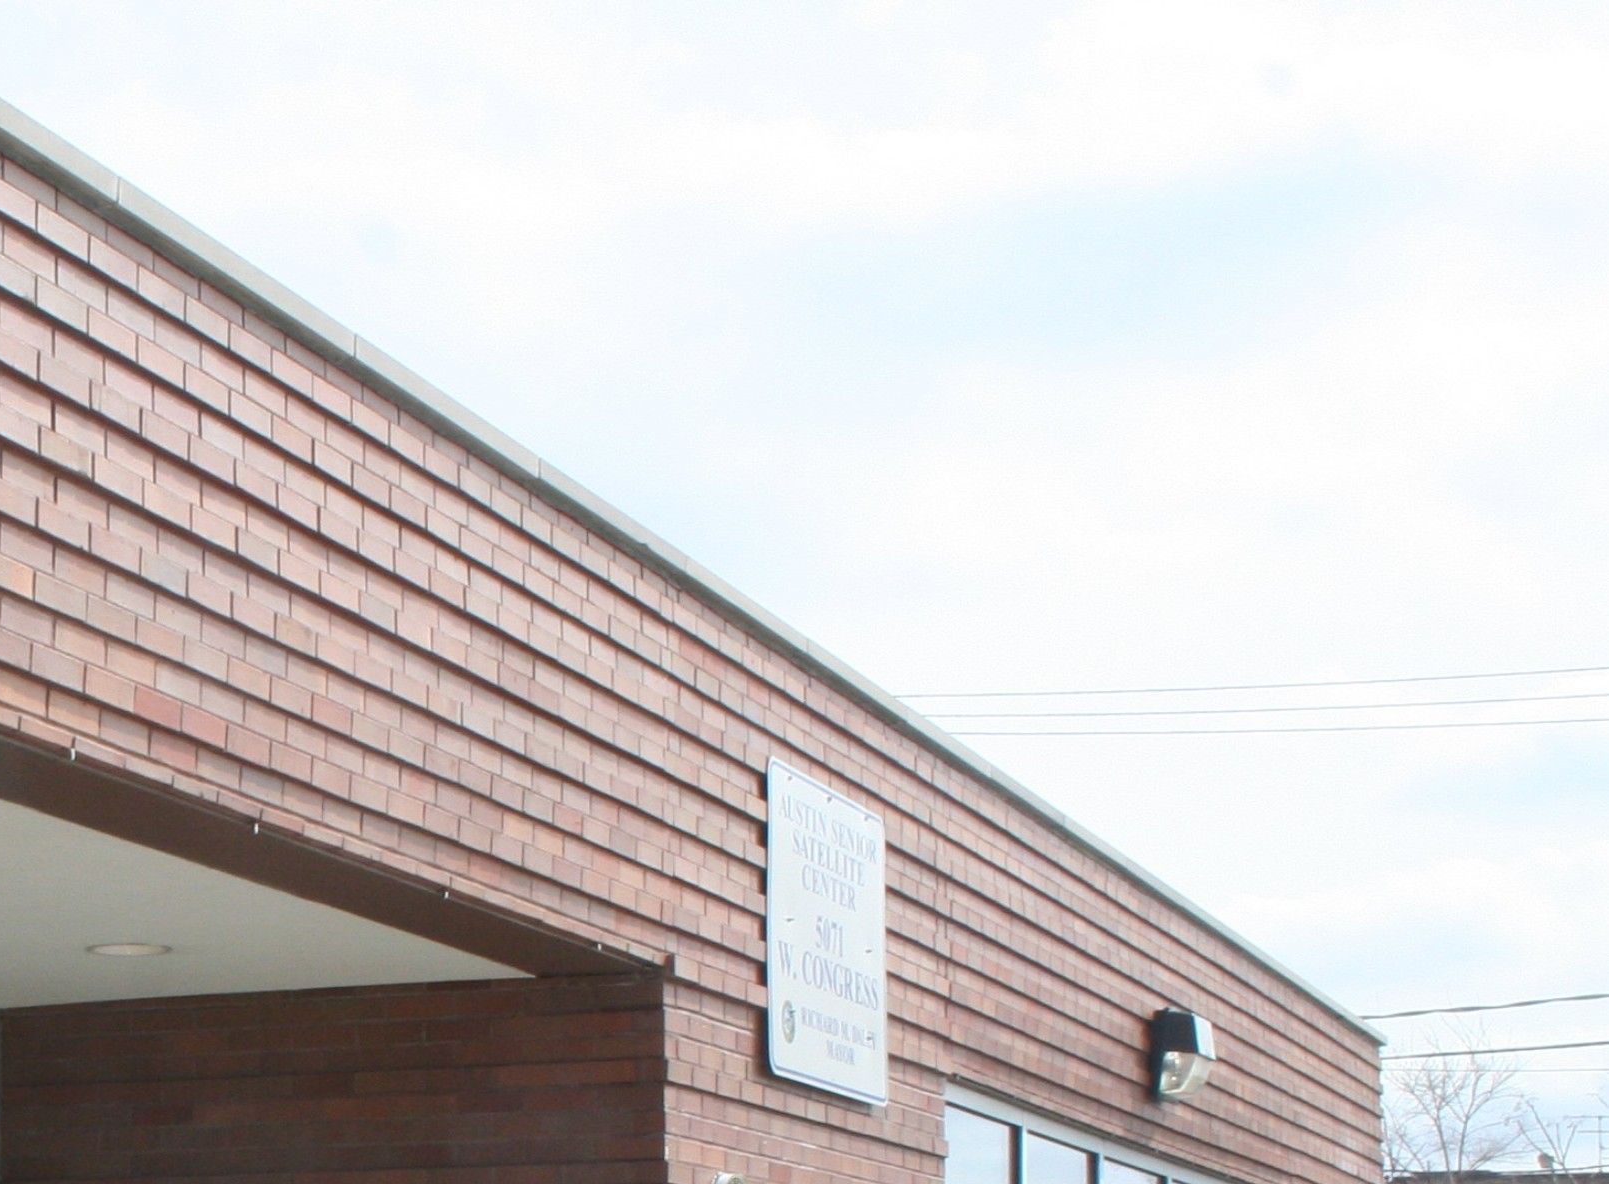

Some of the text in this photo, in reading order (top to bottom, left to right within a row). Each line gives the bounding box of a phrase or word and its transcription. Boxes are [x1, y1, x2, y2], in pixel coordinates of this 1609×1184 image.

[779, 793, 877, 864] AUSTIN SENIOR
[792, 829, 865, 886] SATELLITE
[801, 863, 856, 912] CENTER
[815, 915, 843, 957] 5071
[778, 940, 878, 1010] W. CONGRESS
